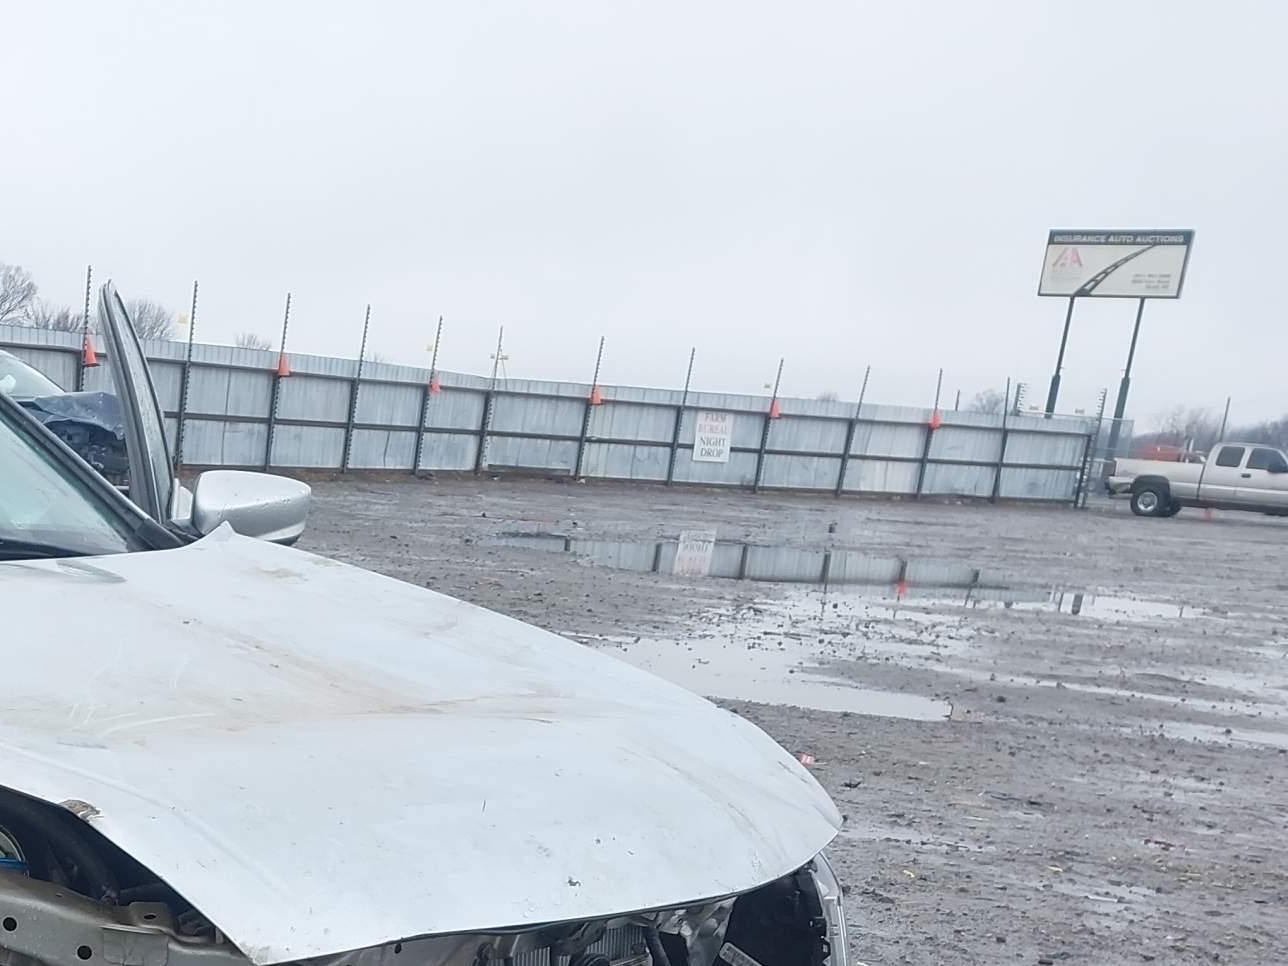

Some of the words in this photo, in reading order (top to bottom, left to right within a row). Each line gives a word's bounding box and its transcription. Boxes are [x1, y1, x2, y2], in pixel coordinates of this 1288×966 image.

[1054, 234, 1106, 244] INSURANCE
[1107, 234, 1134, 244] AUTO
[1135, 234, 1185, 244] AUCTIONS
[700, 436, 726, 447] NIGHT
[700, 447, 724, 458] DROP
